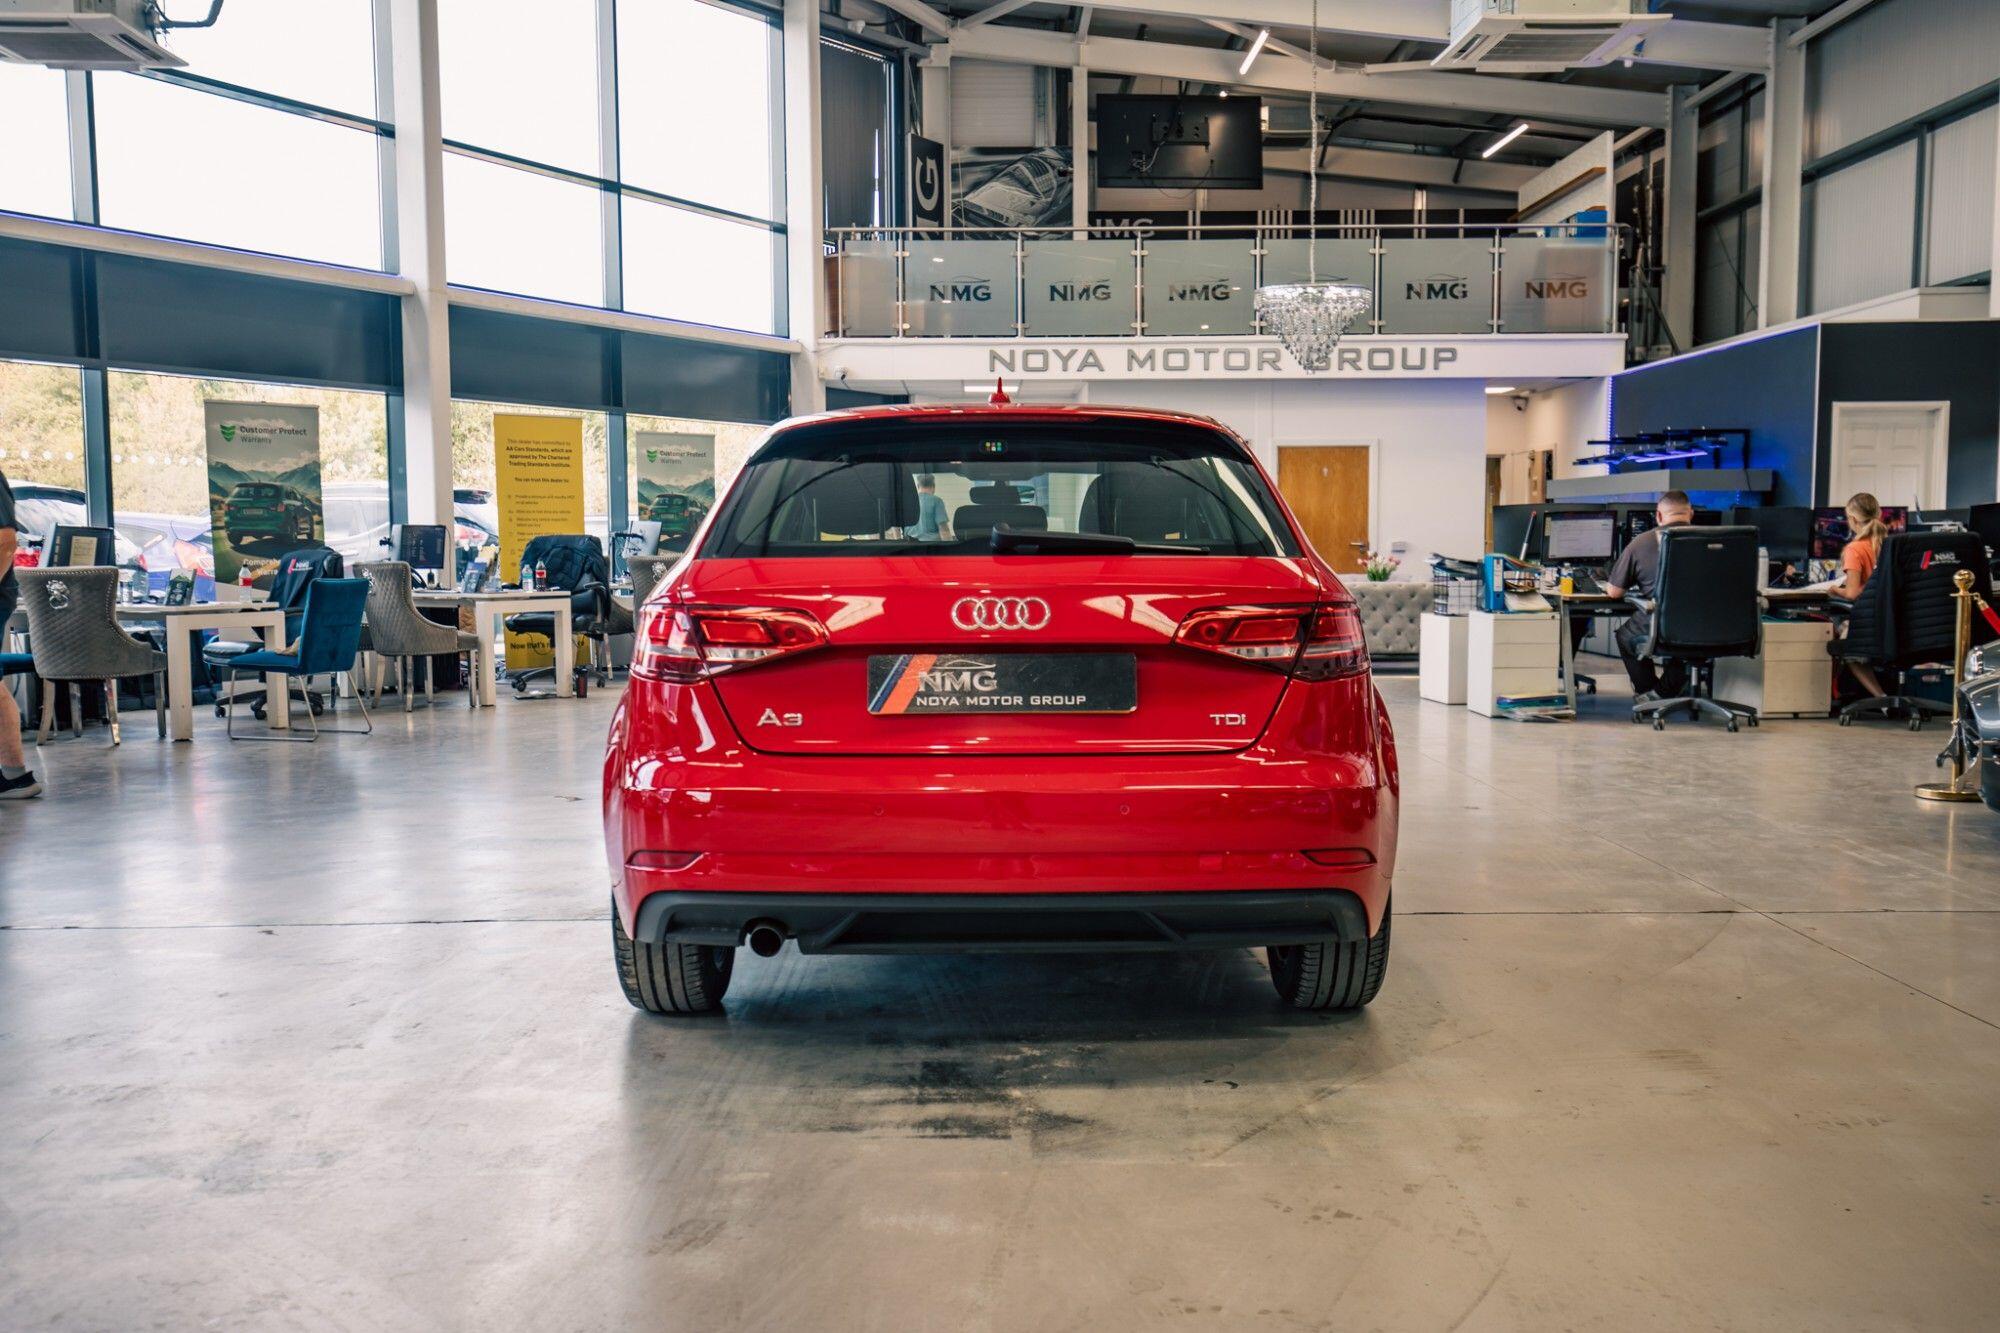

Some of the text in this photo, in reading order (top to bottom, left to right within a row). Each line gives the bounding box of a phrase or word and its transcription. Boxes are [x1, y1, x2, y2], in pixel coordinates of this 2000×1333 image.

[930, 284, 992, 301] NMG
[1168, 284, 1230, 301] NMG
[1405, 282, 1468, 300] NMG
[1525, 282, 1588, 299] NMG
[989, 348, 1105, 372] NOYA
[1127, 348, 1282, 371] MOTOR
[240, 426, 307, 436] Customer Protect
[241, 436, 272, 444] Warranty
[243, 557, 281, 566] Compreh
[919, 671, 998, 692] NMG
[916, 695, 1087, 706] NOYA MOTOR GROUP
[756, 708, 803, 727] A3
